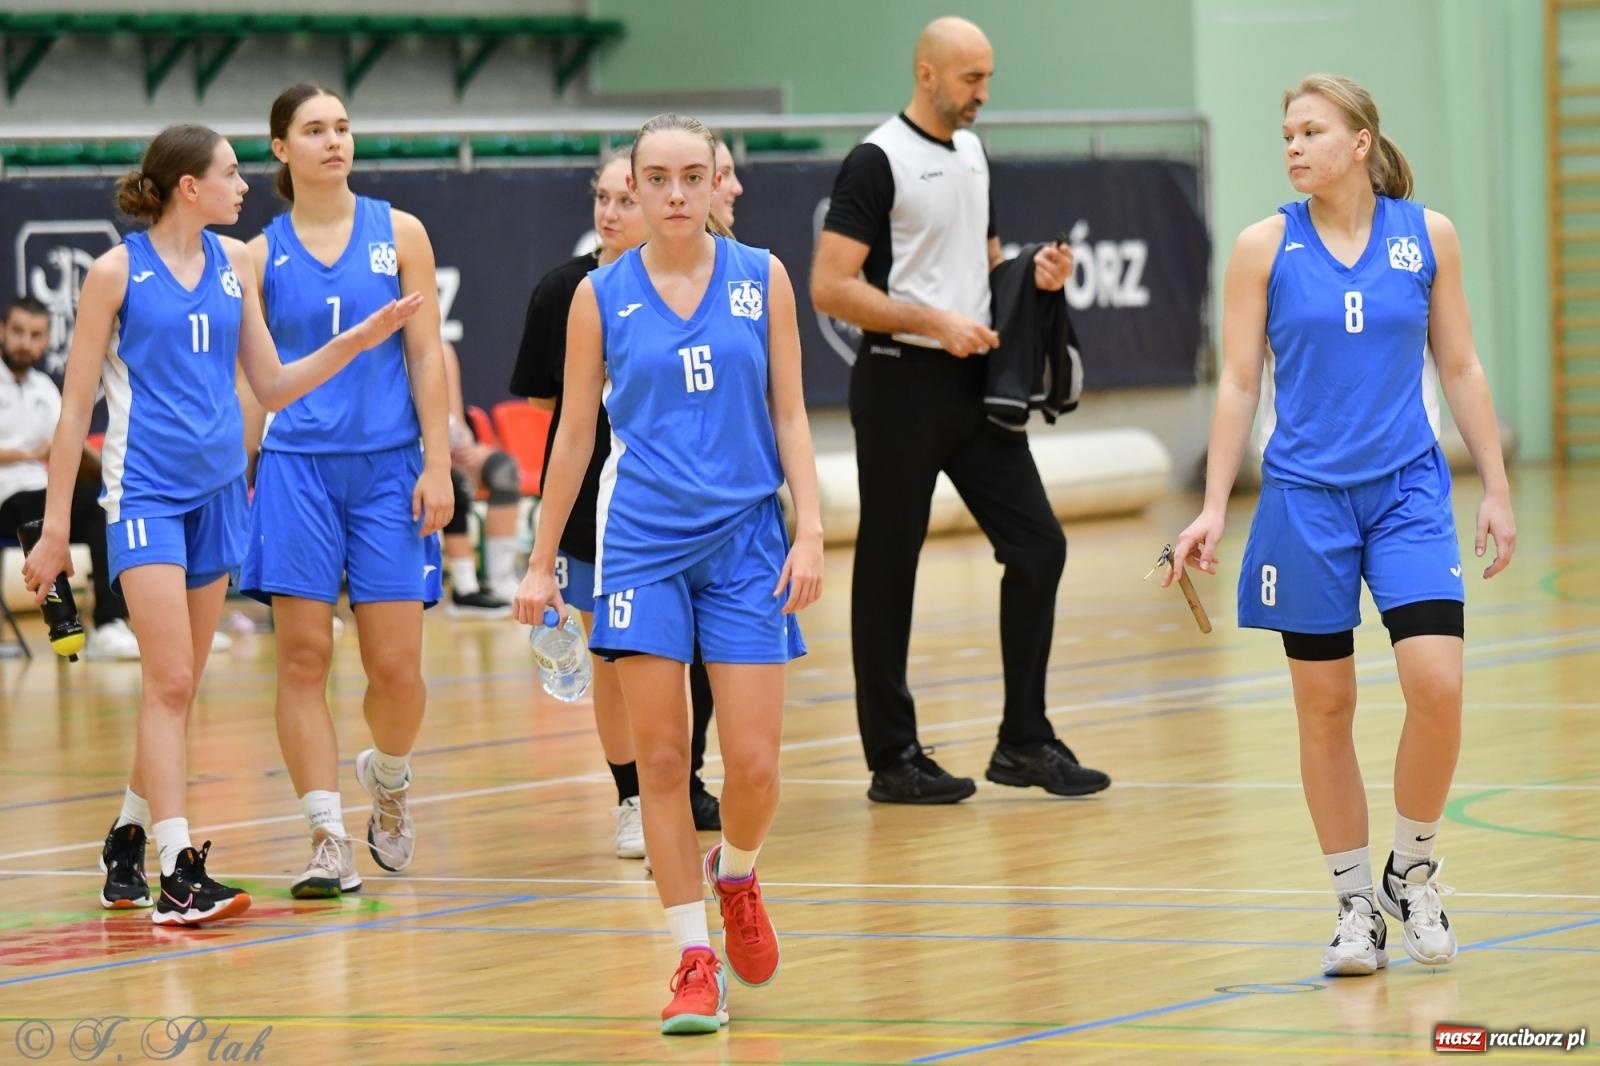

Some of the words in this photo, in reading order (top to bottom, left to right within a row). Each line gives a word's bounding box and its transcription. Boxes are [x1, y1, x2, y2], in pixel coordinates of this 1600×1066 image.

[326, 296, 341, 336] 7
[1344, 290, 1364, 334] 8
[188, 313, 210, 353] 11
[678, 344, 714, 393] 15
[126, 518, 148, 550] 11
[1261, 564, 1277, 607] 8
[608, 588, 635, 629] 15
